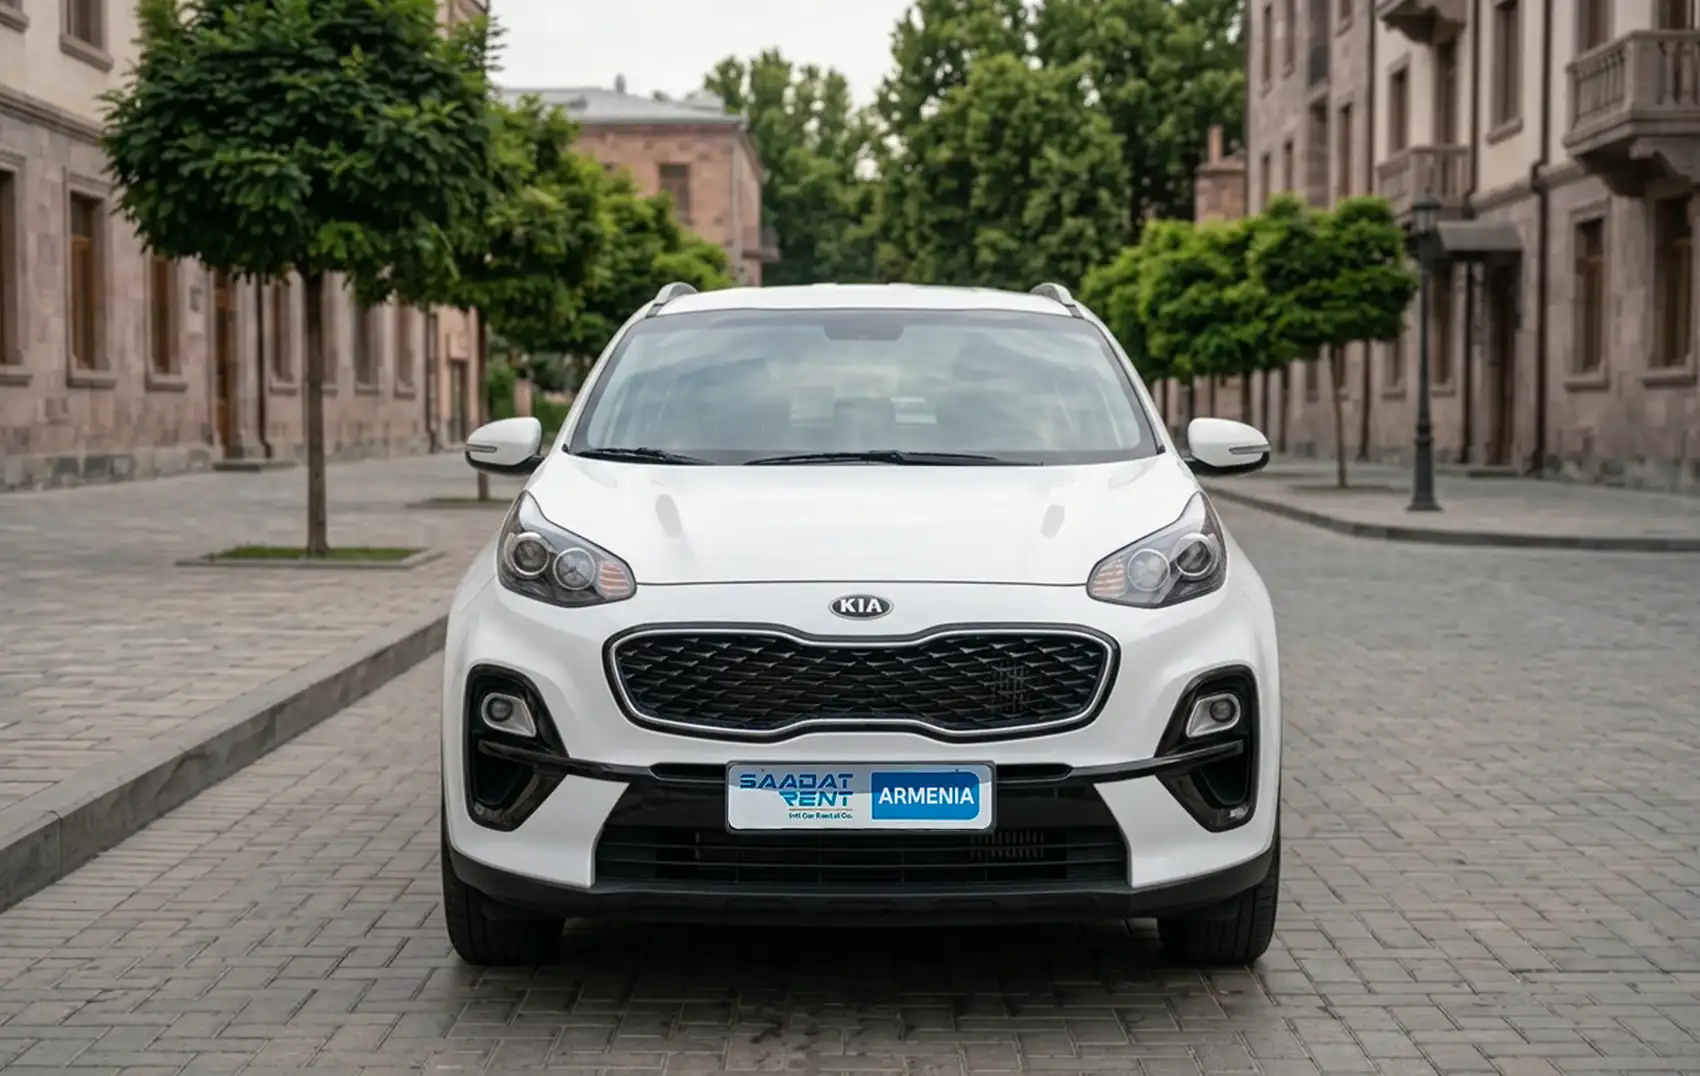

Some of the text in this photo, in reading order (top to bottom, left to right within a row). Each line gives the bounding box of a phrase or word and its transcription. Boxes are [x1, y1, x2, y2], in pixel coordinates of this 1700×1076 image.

[840, 598, 882, 613] KIA
[739, 773, 854, 789] SAADAT
[779, 791, 854, 807] RENT
[878, 786, 975, 805] ARMENIA
[802, 812, 815, 820] Car
